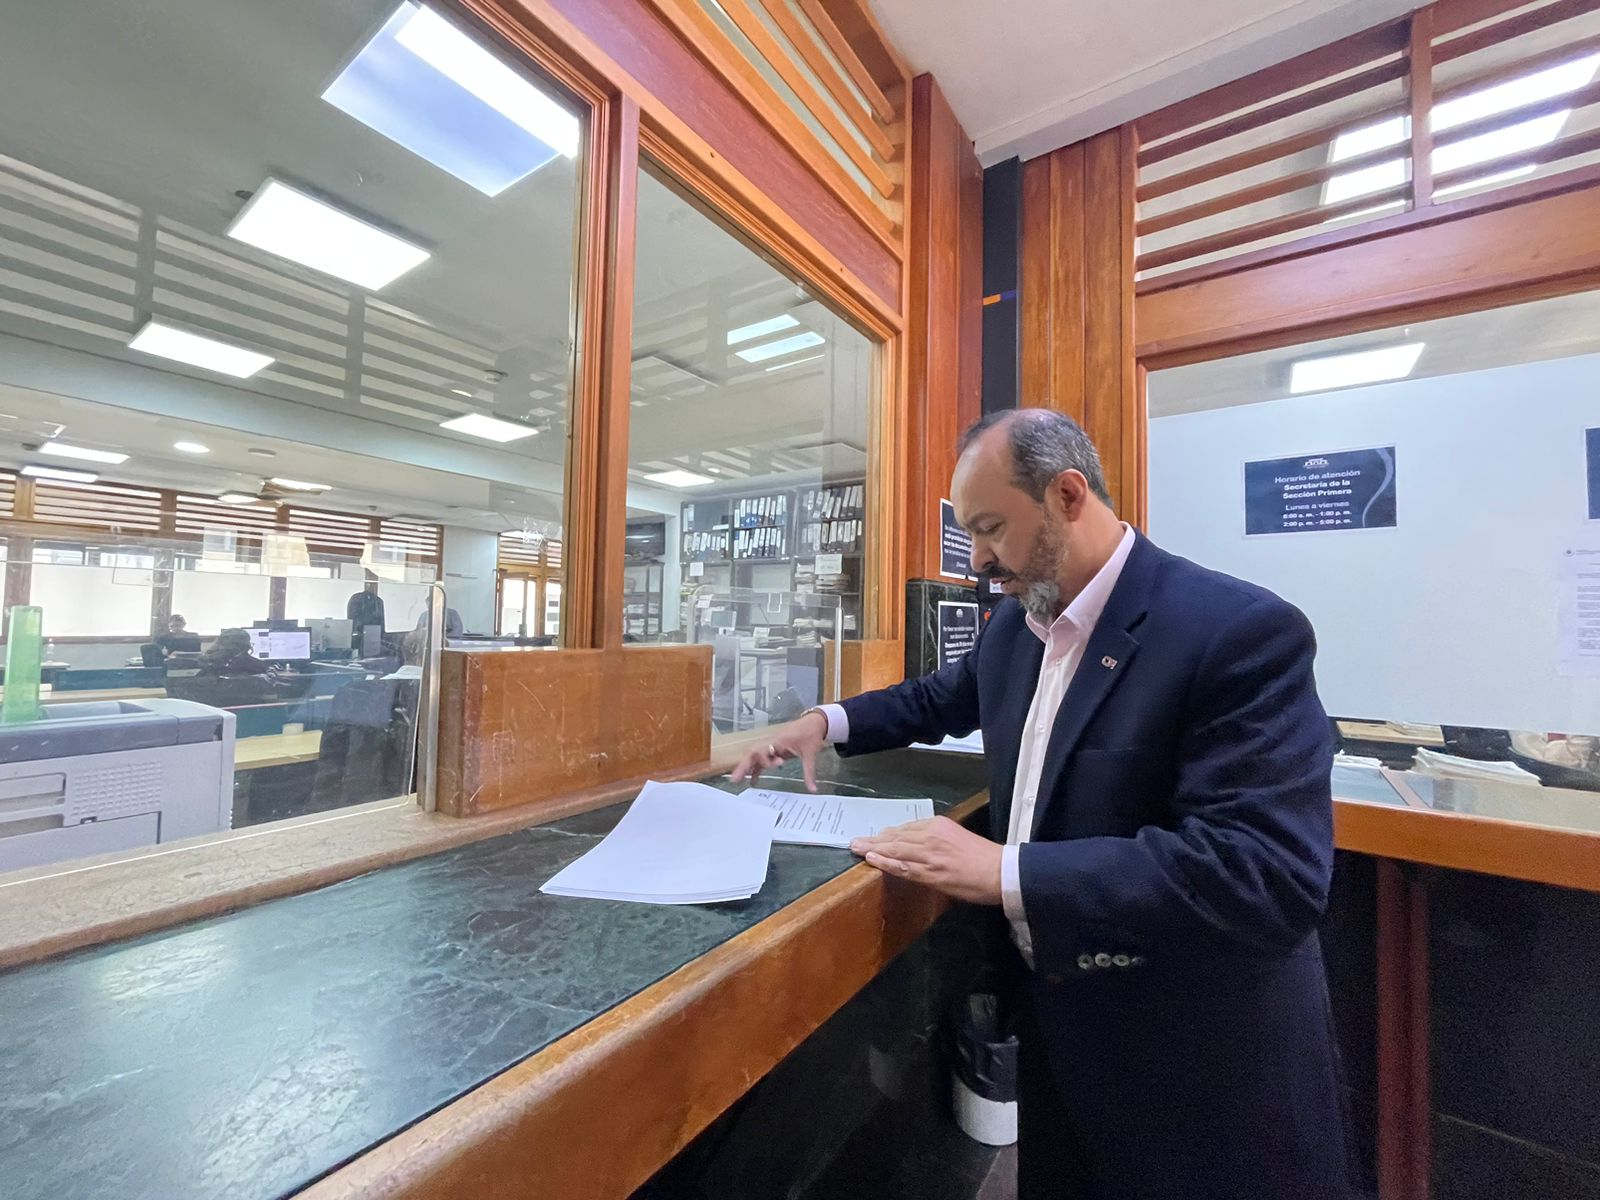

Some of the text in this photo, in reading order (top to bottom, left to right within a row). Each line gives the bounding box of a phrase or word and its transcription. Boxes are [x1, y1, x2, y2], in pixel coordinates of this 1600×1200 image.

[1274, 475, 1307, 483] Horario
[1321, 470, 1360, 478] atención
[1282, 488, 1352, 499] Sección Primera
